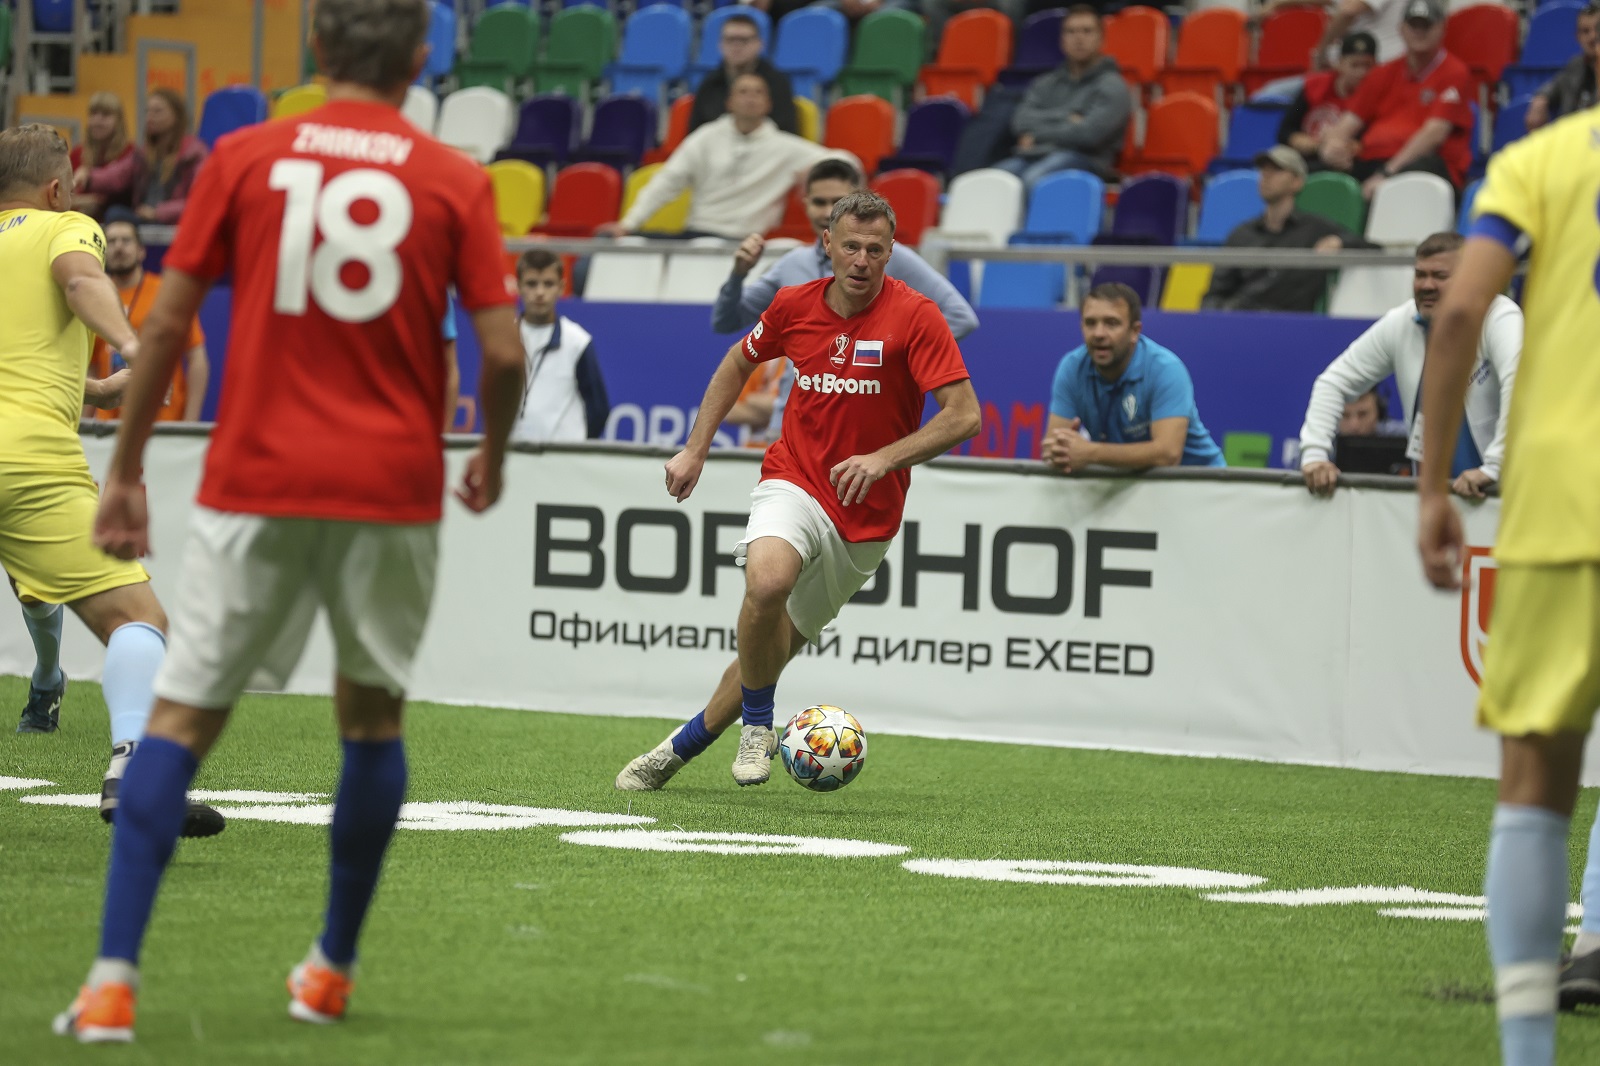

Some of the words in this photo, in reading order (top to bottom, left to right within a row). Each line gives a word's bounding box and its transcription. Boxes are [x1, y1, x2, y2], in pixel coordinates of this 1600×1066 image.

[291, 122, 414, 167] ZHIRKOV
[267, 157, 414, 325] 18
[533, 502, 1159, 619] BORHOF
[530, 609, 841, 659] Официалй
[852, 636, 992, 673] дилер
[1005, 636, 1155, 677] EXEED
